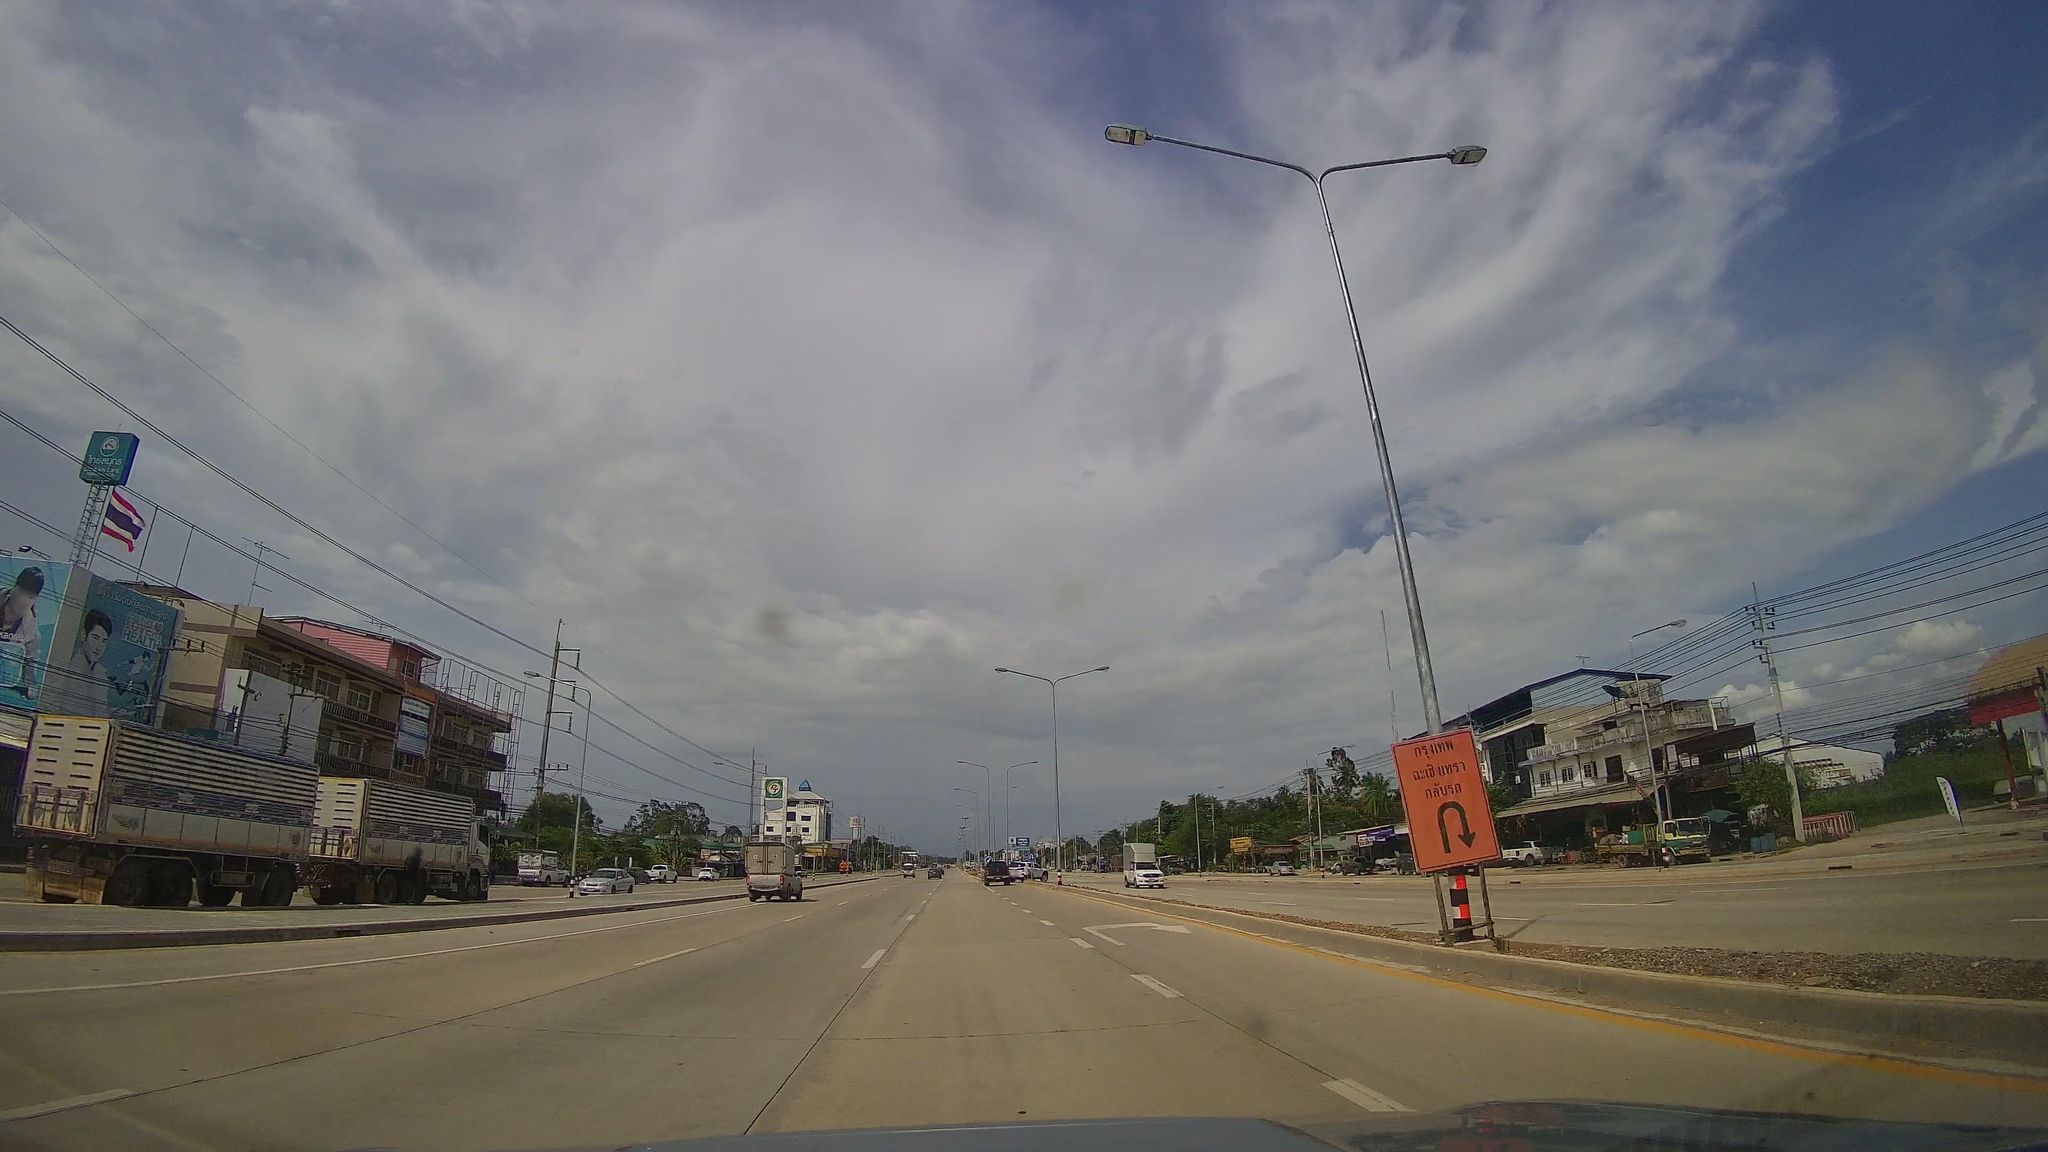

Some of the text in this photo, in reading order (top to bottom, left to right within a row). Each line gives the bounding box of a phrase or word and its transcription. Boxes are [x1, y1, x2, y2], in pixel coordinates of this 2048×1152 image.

[88, 454, 123, 467] ไทยสมุทร
[122, 626, 161, 652] HEALTH
[1414, 740, 1454, 759] กรุงเทพ
[1413, 761, 1466, 780] ฉะเชิงเทรา
[1425, 783, 1462, 799] กลับรถ
